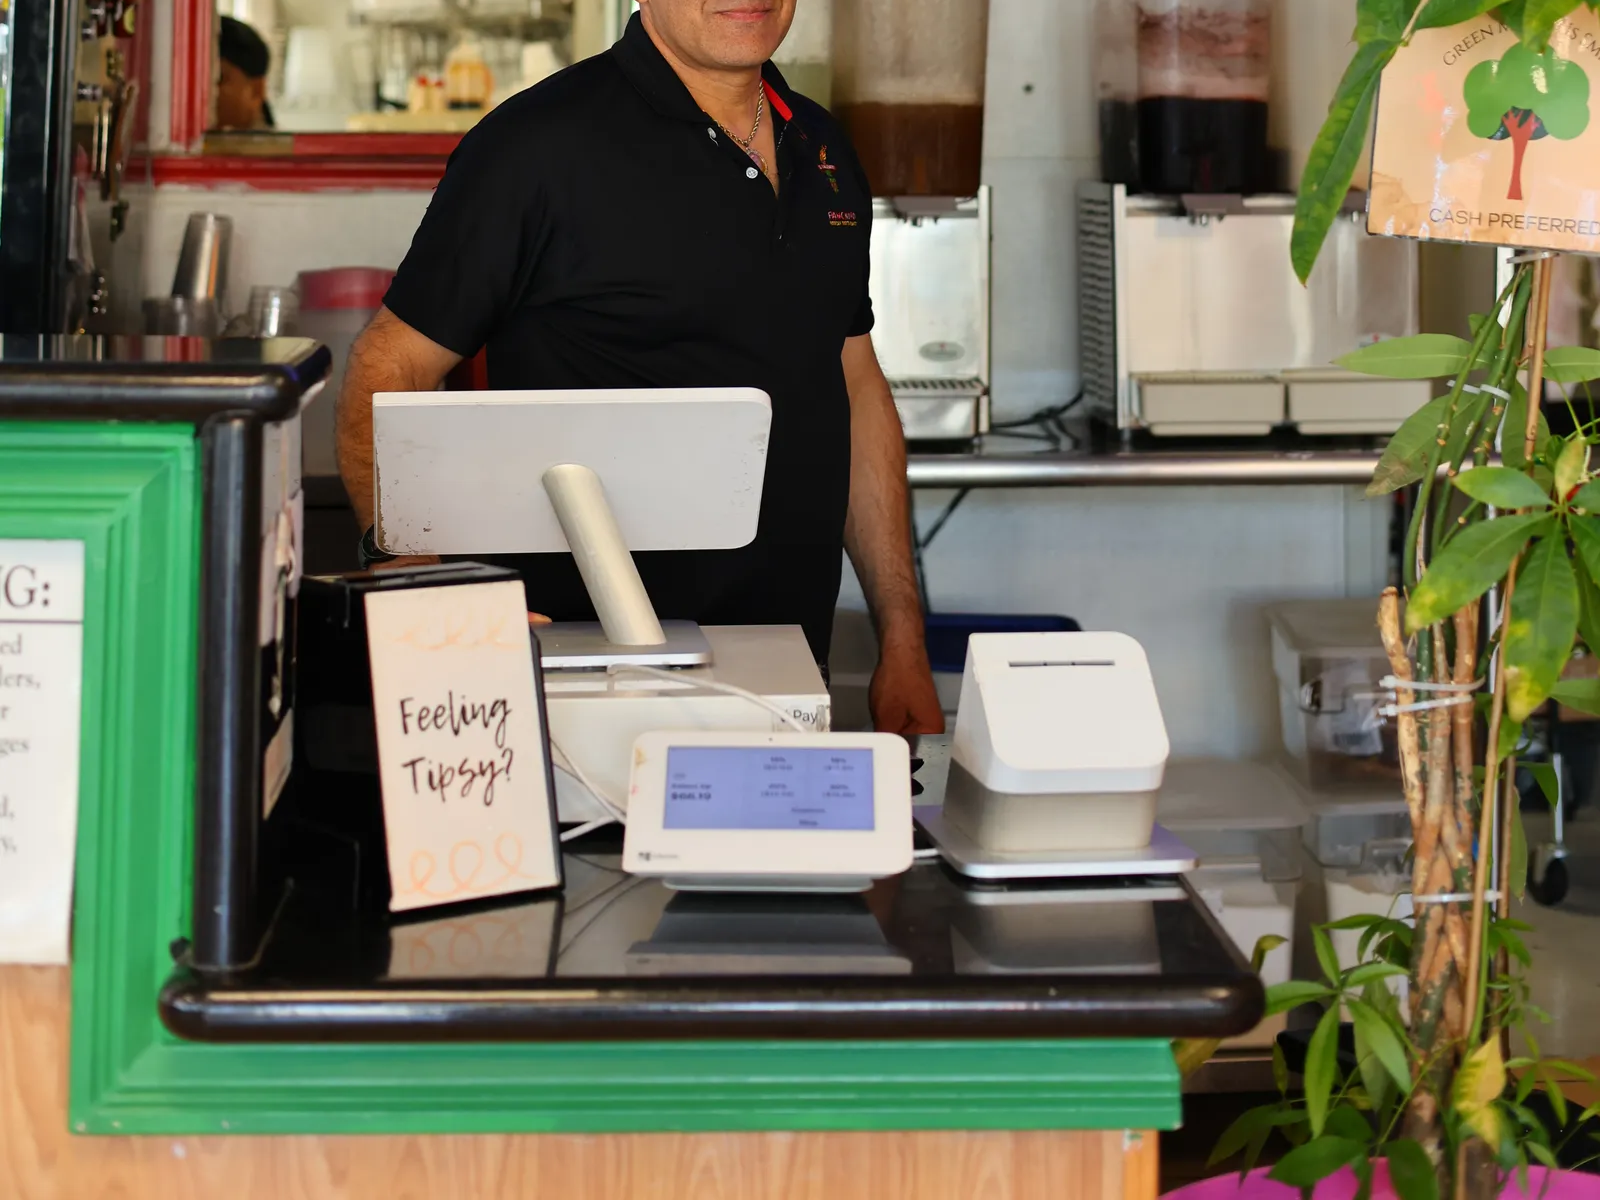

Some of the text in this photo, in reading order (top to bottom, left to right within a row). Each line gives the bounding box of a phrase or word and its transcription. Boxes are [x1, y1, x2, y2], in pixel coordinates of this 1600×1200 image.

[1443, 24, 1494, 65] GREEN
[1429, 208, 1600, 236] CASH PREFERRED
[399, 690, 511, 749] Feeling
[793, 708, 818, 725] Pay
[401, 747, 514, 807] Tipsy?
